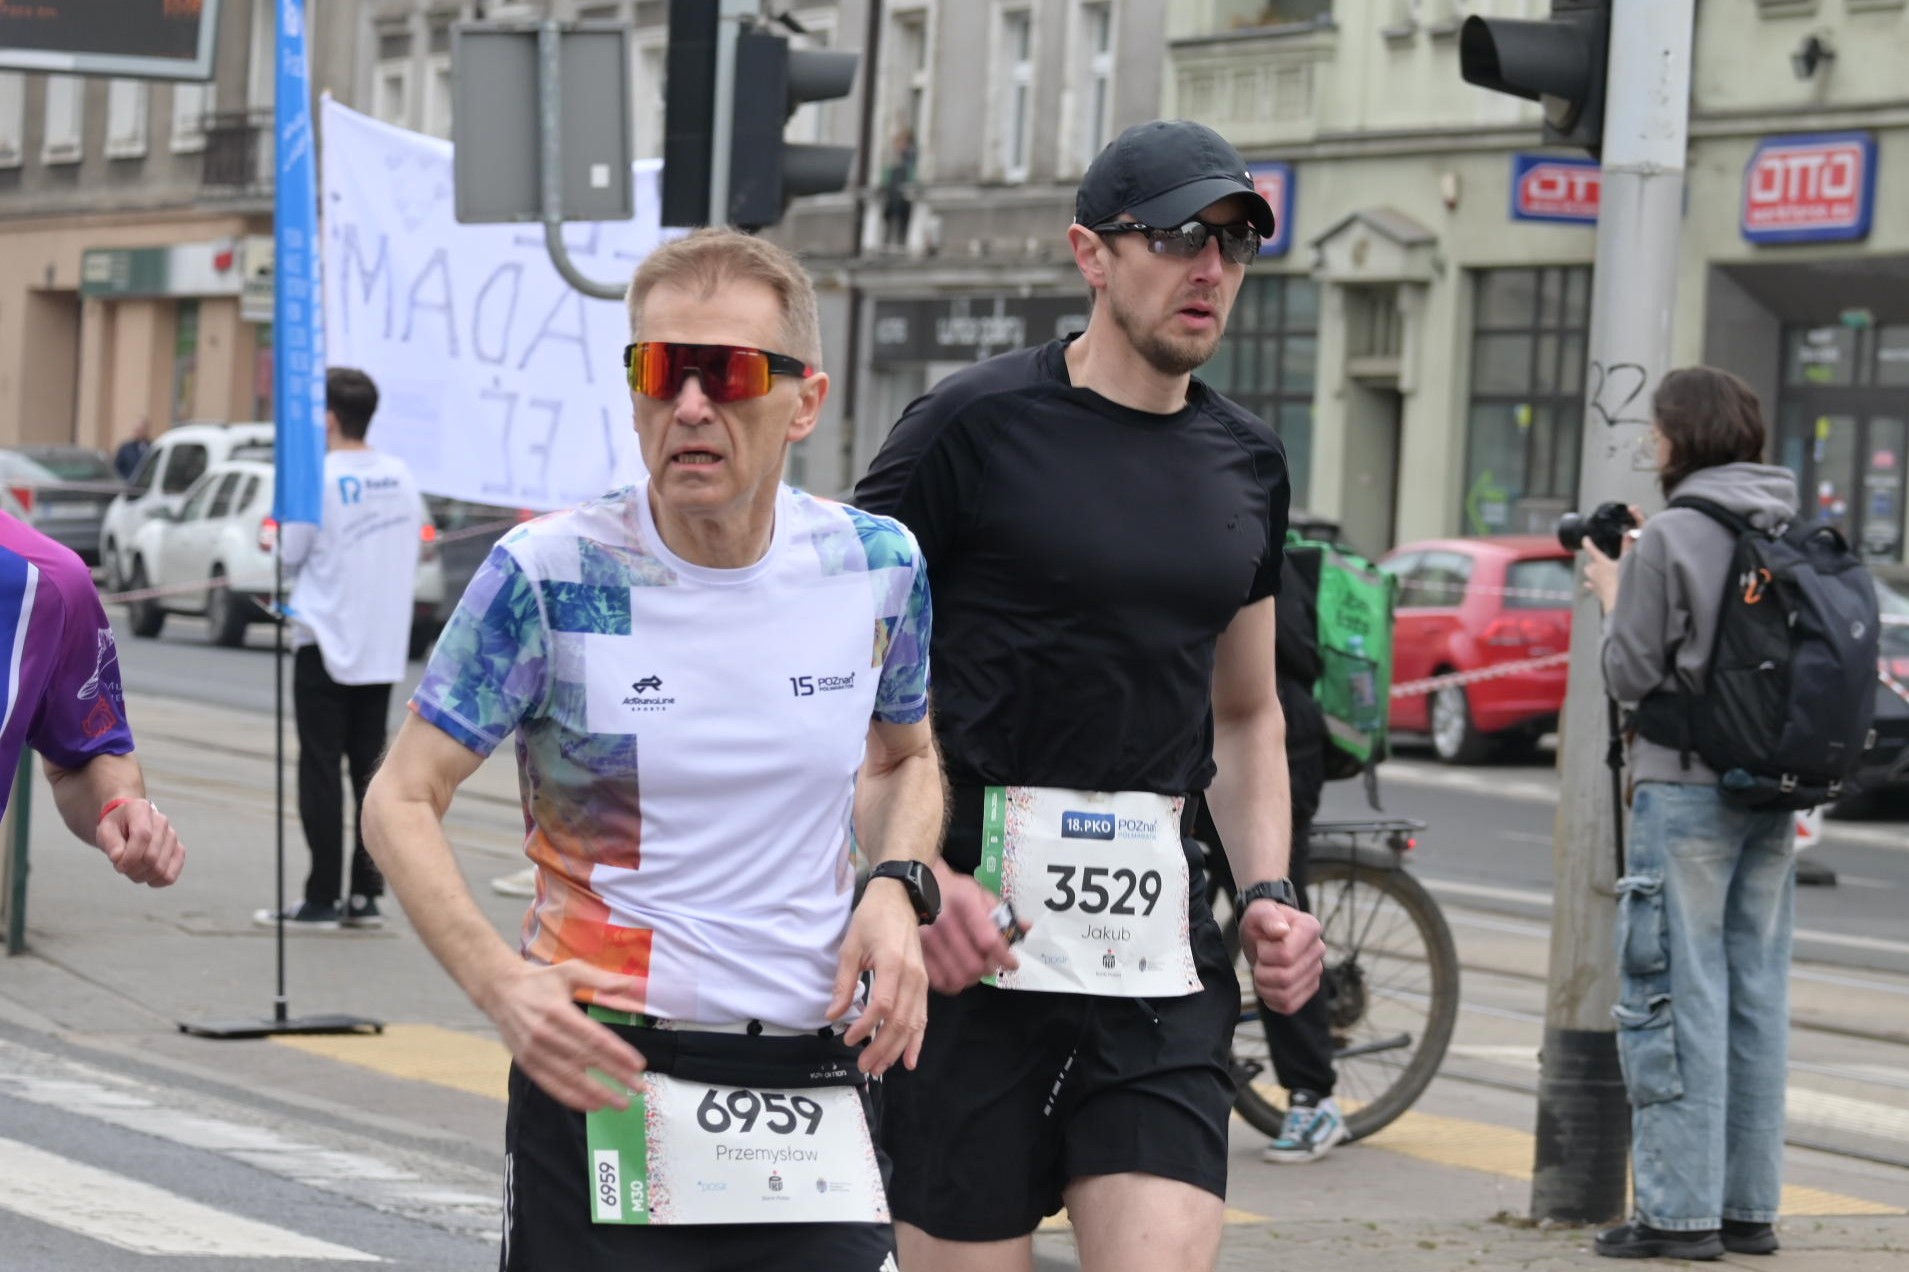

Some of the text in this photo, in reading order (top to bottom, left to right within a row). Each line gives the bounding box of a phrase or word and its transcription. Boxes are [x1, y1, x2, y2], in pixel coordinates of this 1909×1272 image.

[1752, 152, 1854, 203] OTTO
[789, 675, 815, 697] 15
[1066, 817, 1111, 834] 18.PKO
[1043, 863, 1163, 917] 3529
[1081, 924, 1131, 942] Jakub
[696, 1087, 824, 1136] 6959
[715, 1143, 819, 1165] Przemysław
[598, 1160, 617, 1207] 6959
[630, 1180, 645, 1213] M30
